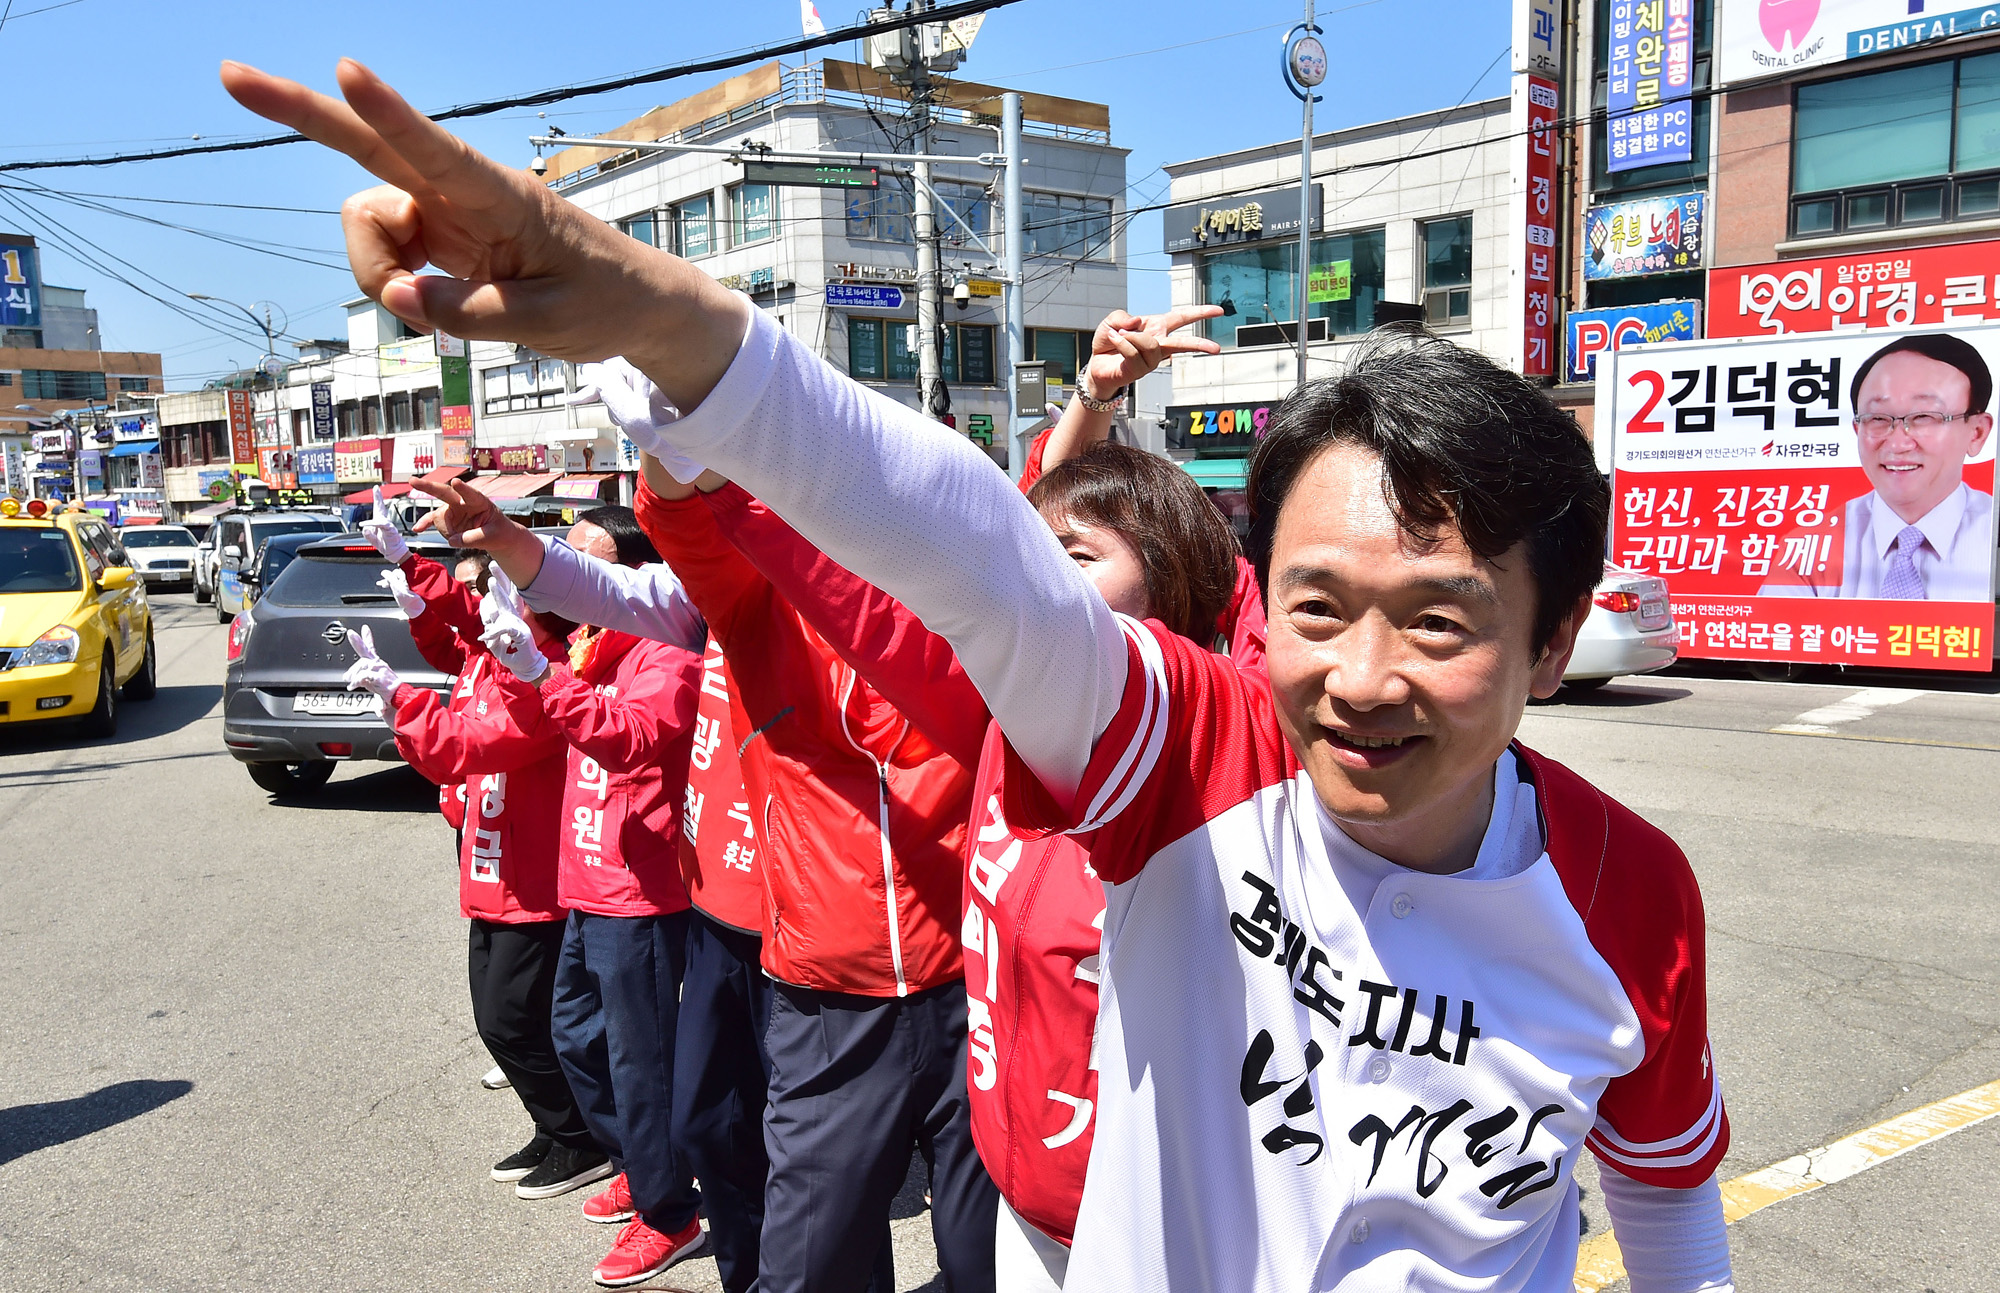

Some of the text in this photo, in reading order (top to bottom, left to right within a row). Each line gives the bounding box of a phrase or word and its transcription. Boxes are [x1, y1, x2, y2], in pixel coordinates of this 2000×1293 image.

[1533, 0, 1555, 52] 과
[1858, 17, 1963, 54] DENTAL
[1612, 0, 1631, 94] 이밍 모니터
[1752, 36, 1825, 68] DENTAL CLINIC
[1612, 110, 1687, 138] 친절한 PC
[1612, 131, 1687, 158] 청결한 PC
[1271, 217, 1315, 231] HAIR SP
[1533, 227, 1549, 244] 금강
[1610, 205, 1681, 255] 큐브 노래
[1682, 198, 1700, 251] 연습장
[1837, 259, 1912, 284] 일공공일
[0, 288, 33, 315] 식
[827, 286, 881, 299] 전곡로164번길
[1528, 253, 1550, 370] 보청기
[301, 452, 333, 473] 광신약국
[1626, 442, 1840, 461] 경기도의회의원선거 연천군선거구 자유한국당
[1623, 484, 1839, 528] 헌신, 진정성,
[1622, 533, 1833, 576] 군민과 함께!
[1698, 604, 1753, 617] 연천군선거구
[1704, 620, 1794, 651] 연천군을
[1799, 624, 1825, 653] 잘
[1830, 626, 1879, 654] 아는
[1886, 624, 1981, 658] 김덕현!
[302, 692, 374, 708] 56보 0497
[584, 854, 602, 867] 후보
[722, 840, 756, 873] 후보
